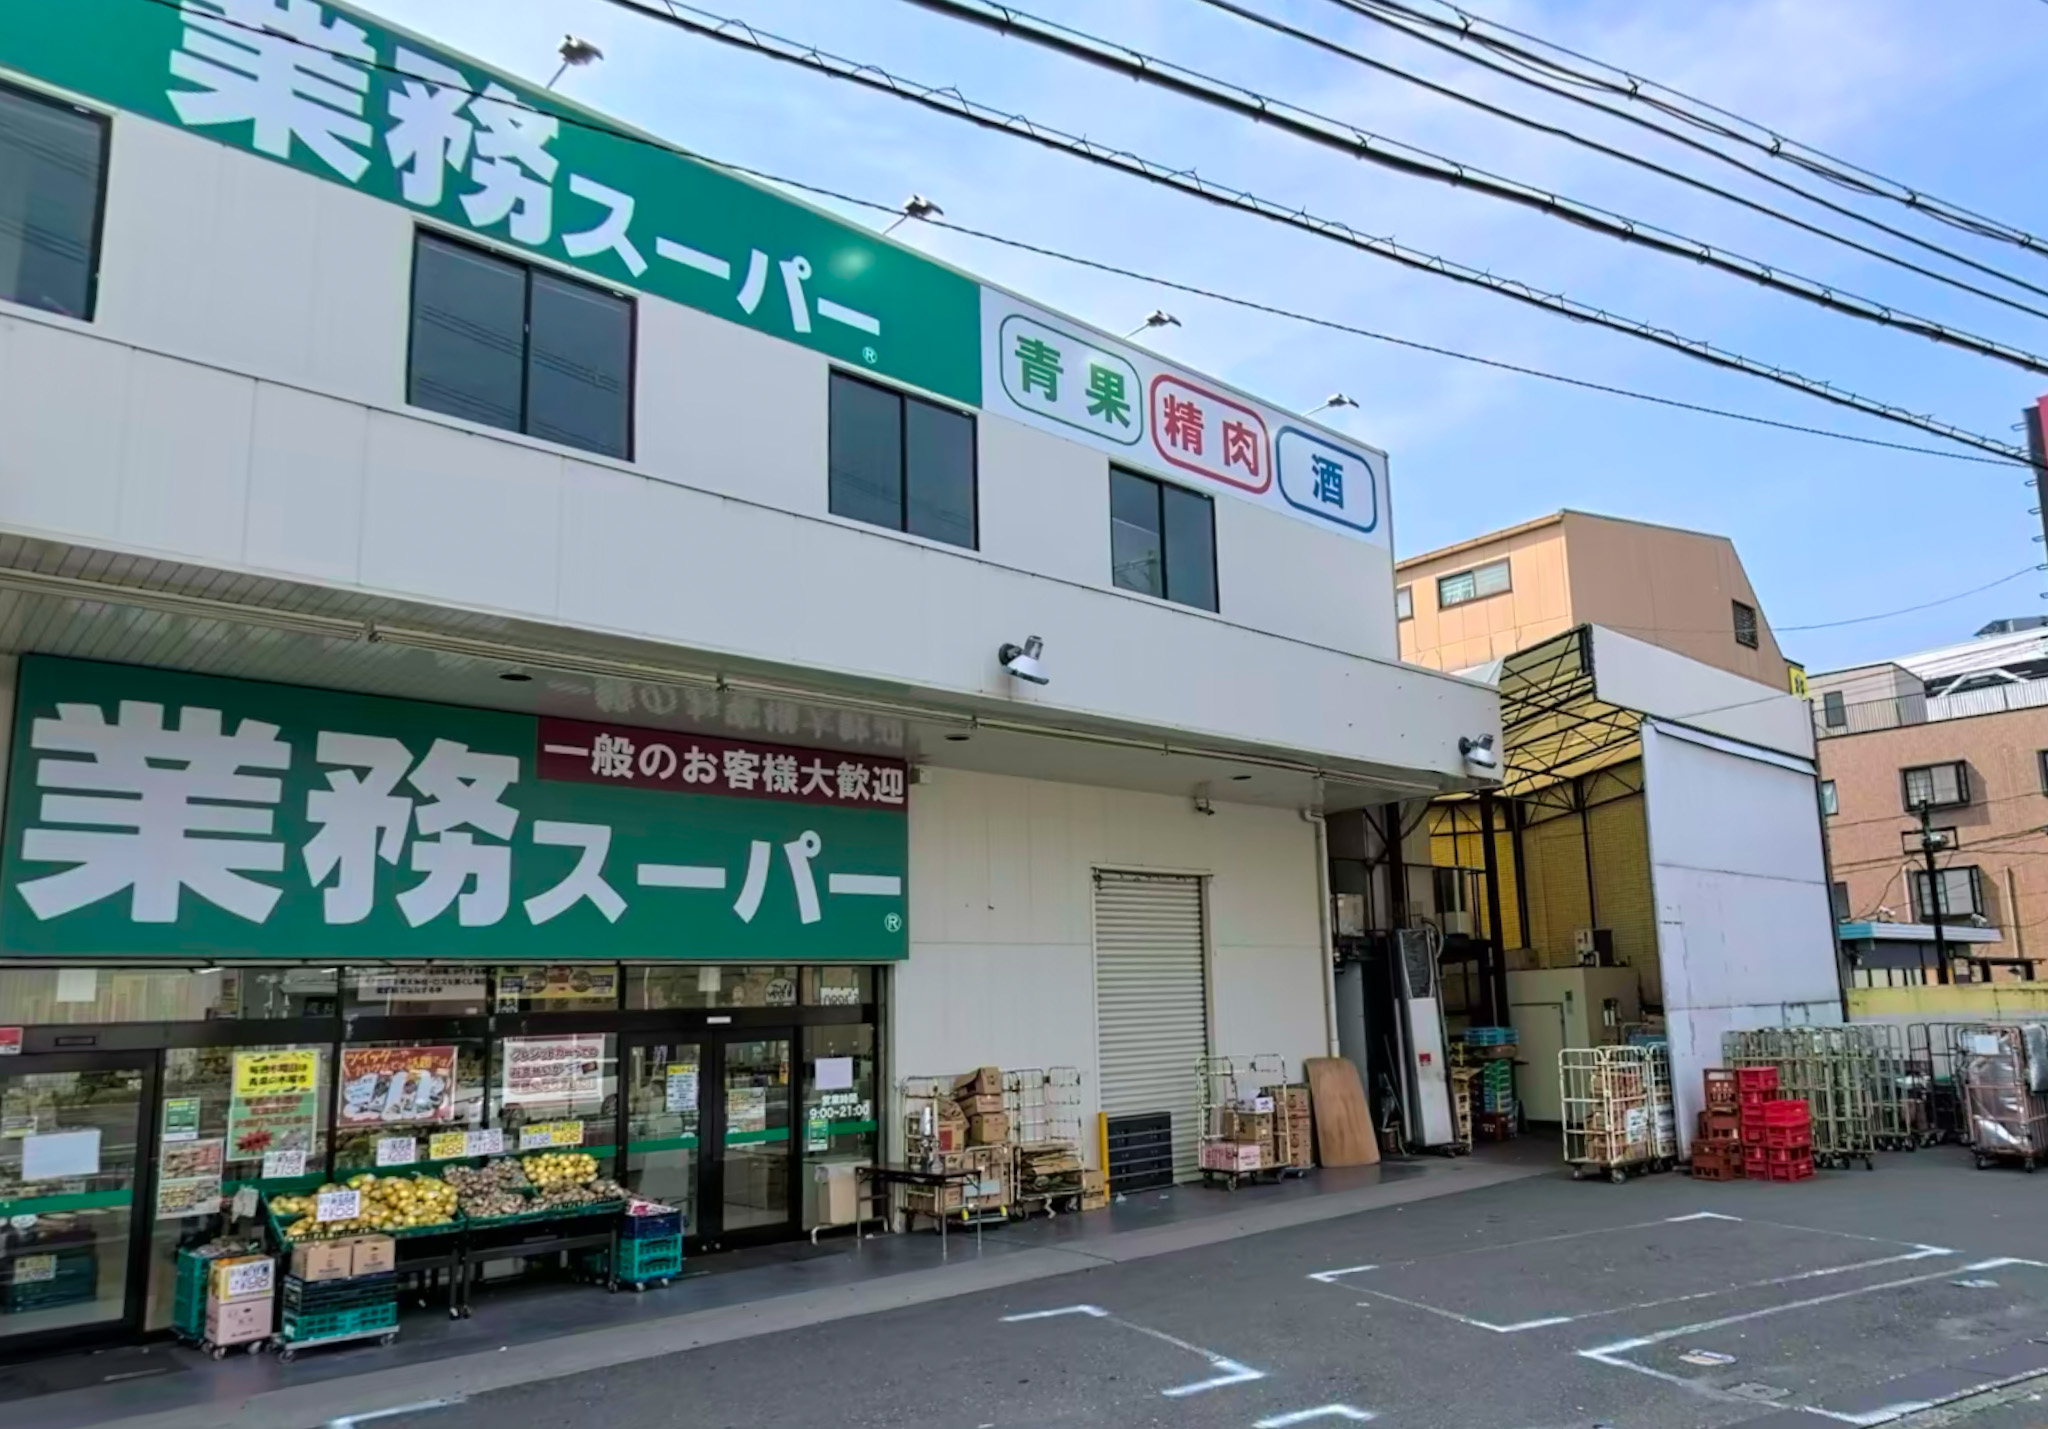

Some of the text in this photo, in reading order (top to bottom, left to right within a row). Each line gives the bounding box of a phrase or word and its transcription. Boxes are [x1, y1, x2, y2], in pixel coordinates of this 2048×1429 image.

[166, 0, 880, 336] 業務スーパー
[1013, 334, 1132, 429] 青果
[1162, 393, 1261, 477] 精肉
[1310, 453, 1346, 511] 酒
[543, 731, 905, 804] 一般のお客様大歓迎
[15, 700, 902, 929] 業務スーパー
